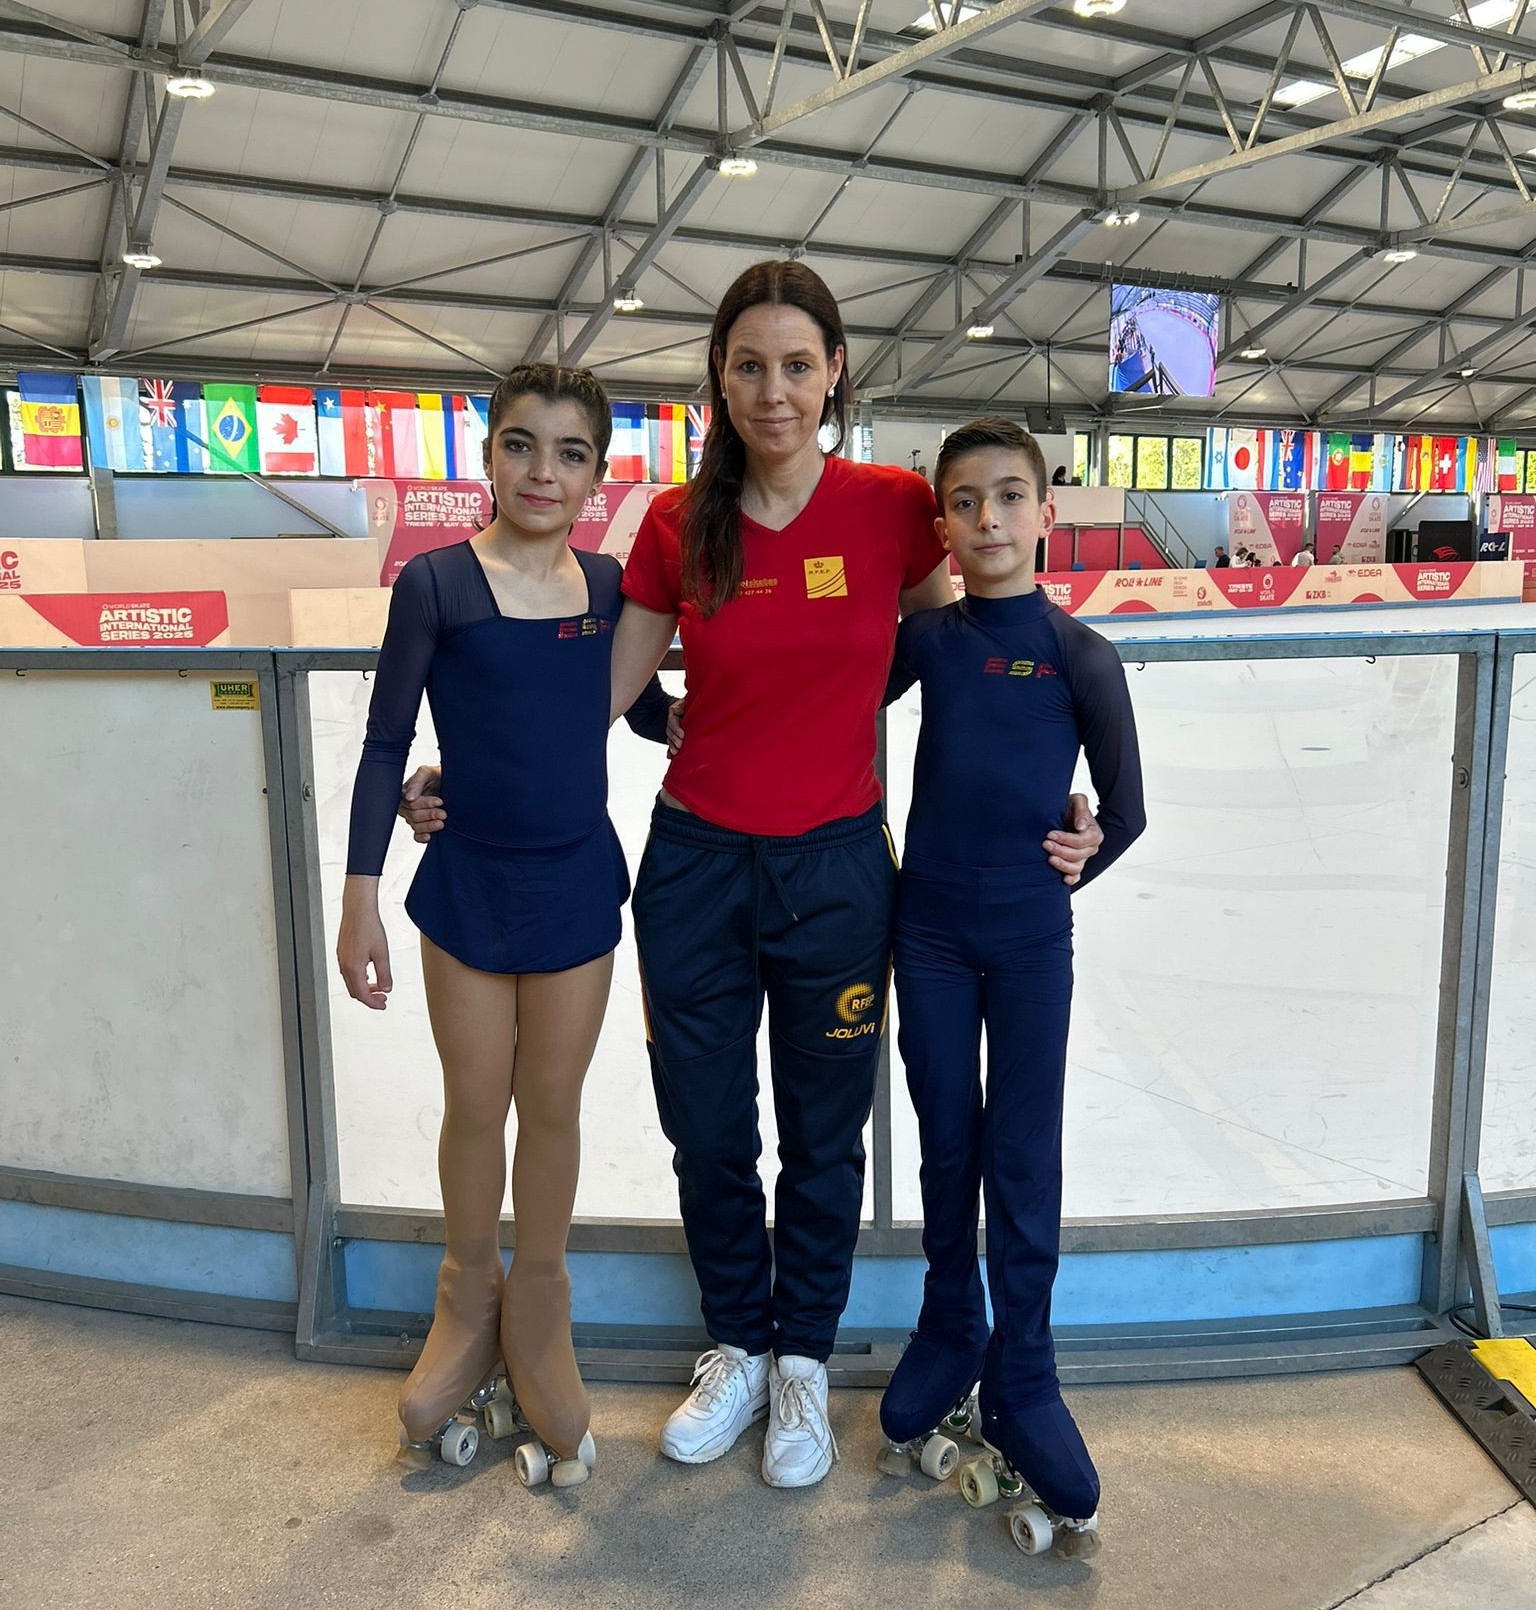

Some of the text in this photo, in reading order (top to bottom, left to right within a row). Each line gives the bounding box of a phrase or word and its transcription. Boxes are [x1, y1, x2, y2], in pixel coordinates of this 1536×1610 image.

[404, 491, 482, 507] ARTISTIC
[1269, 499, 1302, 509] ARTISTIC
[404, 502, 483, 514] INTERNATIONAL
[1320, 500, 1352, 509] ARTISTIC
[1504, 504, 1535, 515] ARTISTIC
[404, 511, 446, 521] SERIES
[1357, 569, 1382, 577] EDEA
[1418, 571, 1450, 581] ARTISTIC
[1144, 577, 1163, 586] LINE
[1312, 590, 1326, 599] ZKB
[99, 607, 192, 623] ARTISTIC
[99, 621, 193, 632] INTERNATIONAL
[101, 630, 193, 641] SERIES 2025
